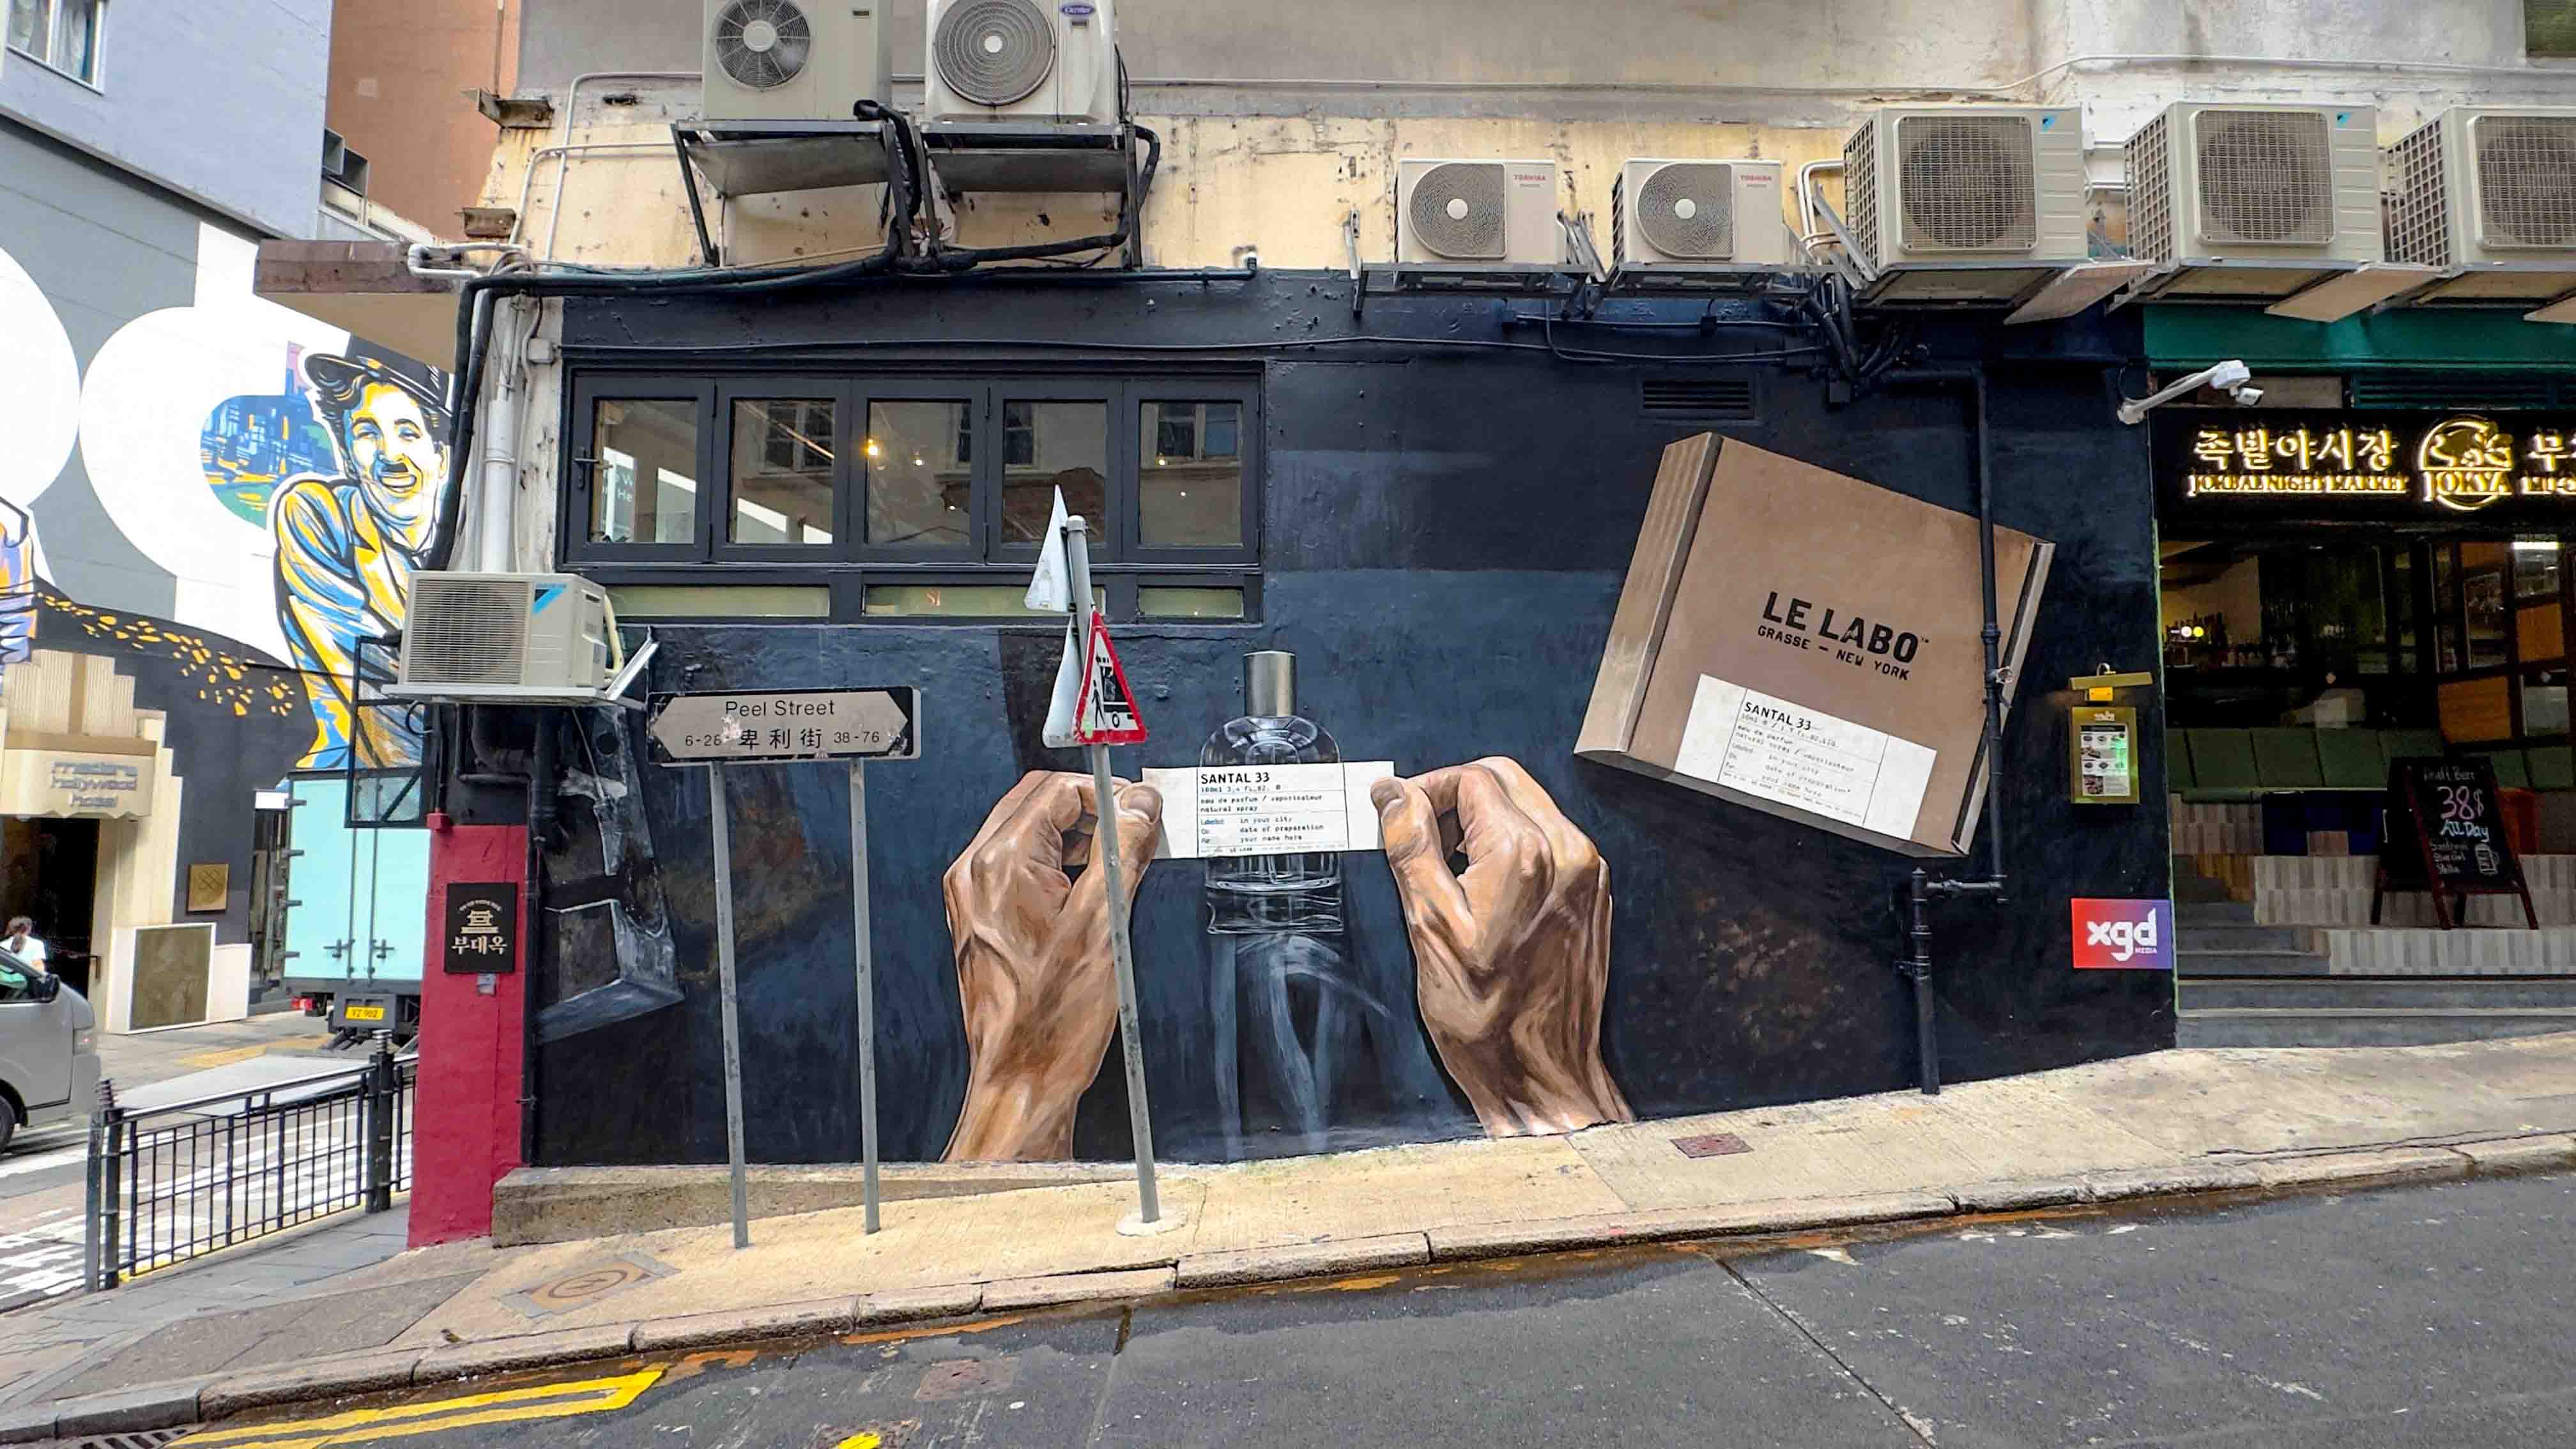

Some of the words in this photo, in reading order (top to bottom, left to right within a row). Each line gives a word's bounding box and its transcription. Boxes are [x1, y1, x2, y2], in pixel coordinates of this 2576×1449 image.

[2193, 429, 2400, 471] 족발야시장
[2423, 470, 2513, 502] JOKYA
[1763, 591, 1812, 631] LE
[1758, 625, 1811, 650] GRASSE
[1836, 648, 1864, 666] NEW
[1874, 660, 1910, 681] YORK
[726, 700, 767, 716] Peel
[774, 700, 836, 716] Street
[1744, 702, 1793, 726] SANTAL
[1796, 717, 1812, 731] 33
[1200, 772, 1252, 785] SANTAL
[1255, 771, 1270, 783] 33
[451, 936, 508, 956] 부대옥
[2086, 907, 2158, 961] xgd
